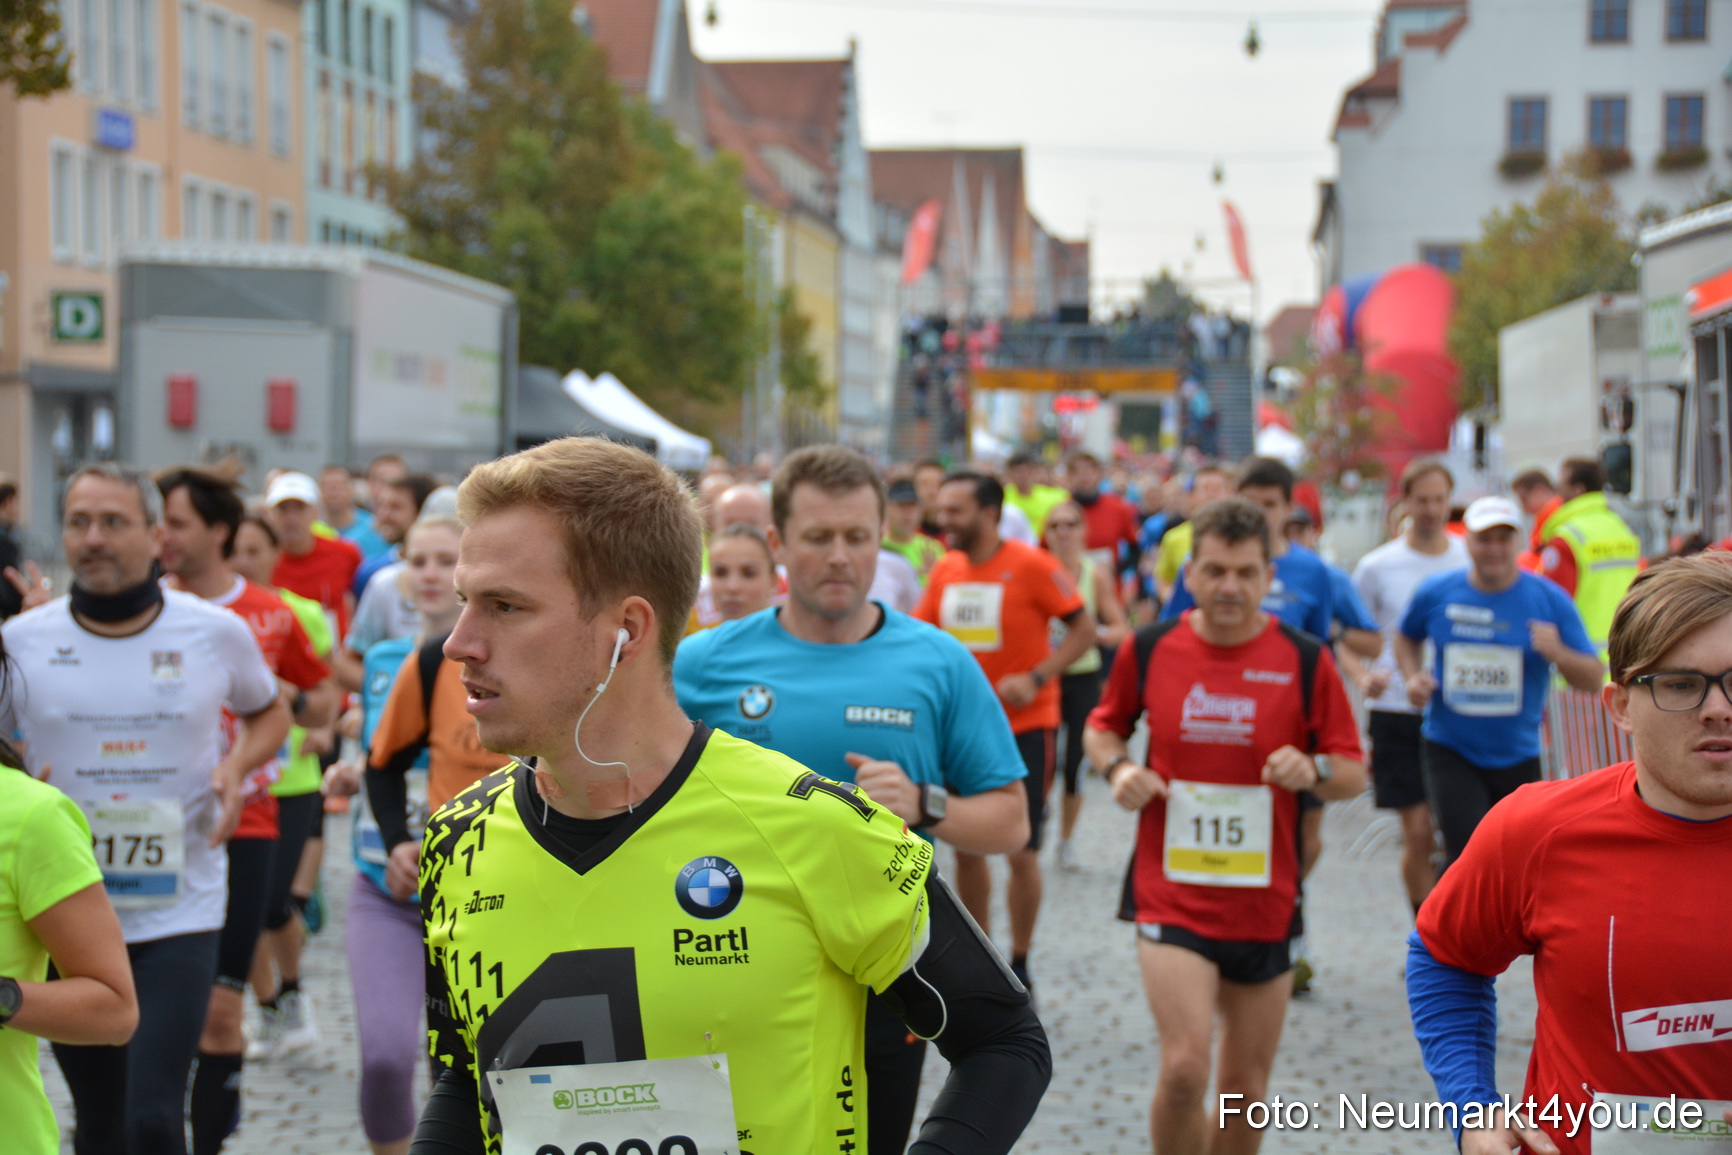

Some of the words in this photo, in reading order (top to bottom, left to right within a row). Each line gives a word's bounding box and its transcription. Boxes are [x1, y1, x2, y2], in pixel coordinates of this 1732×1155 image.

[845, 706, 913, 726] BOCK
[1190, 816, 1244, 847] 115
[673, 926, 748, 953] Partl
[675, 953, 749, 966] Neumarkt
[1656, 1014, 1715, 1036] DEHN
[575, 1083, 660, 1109] BOCK
